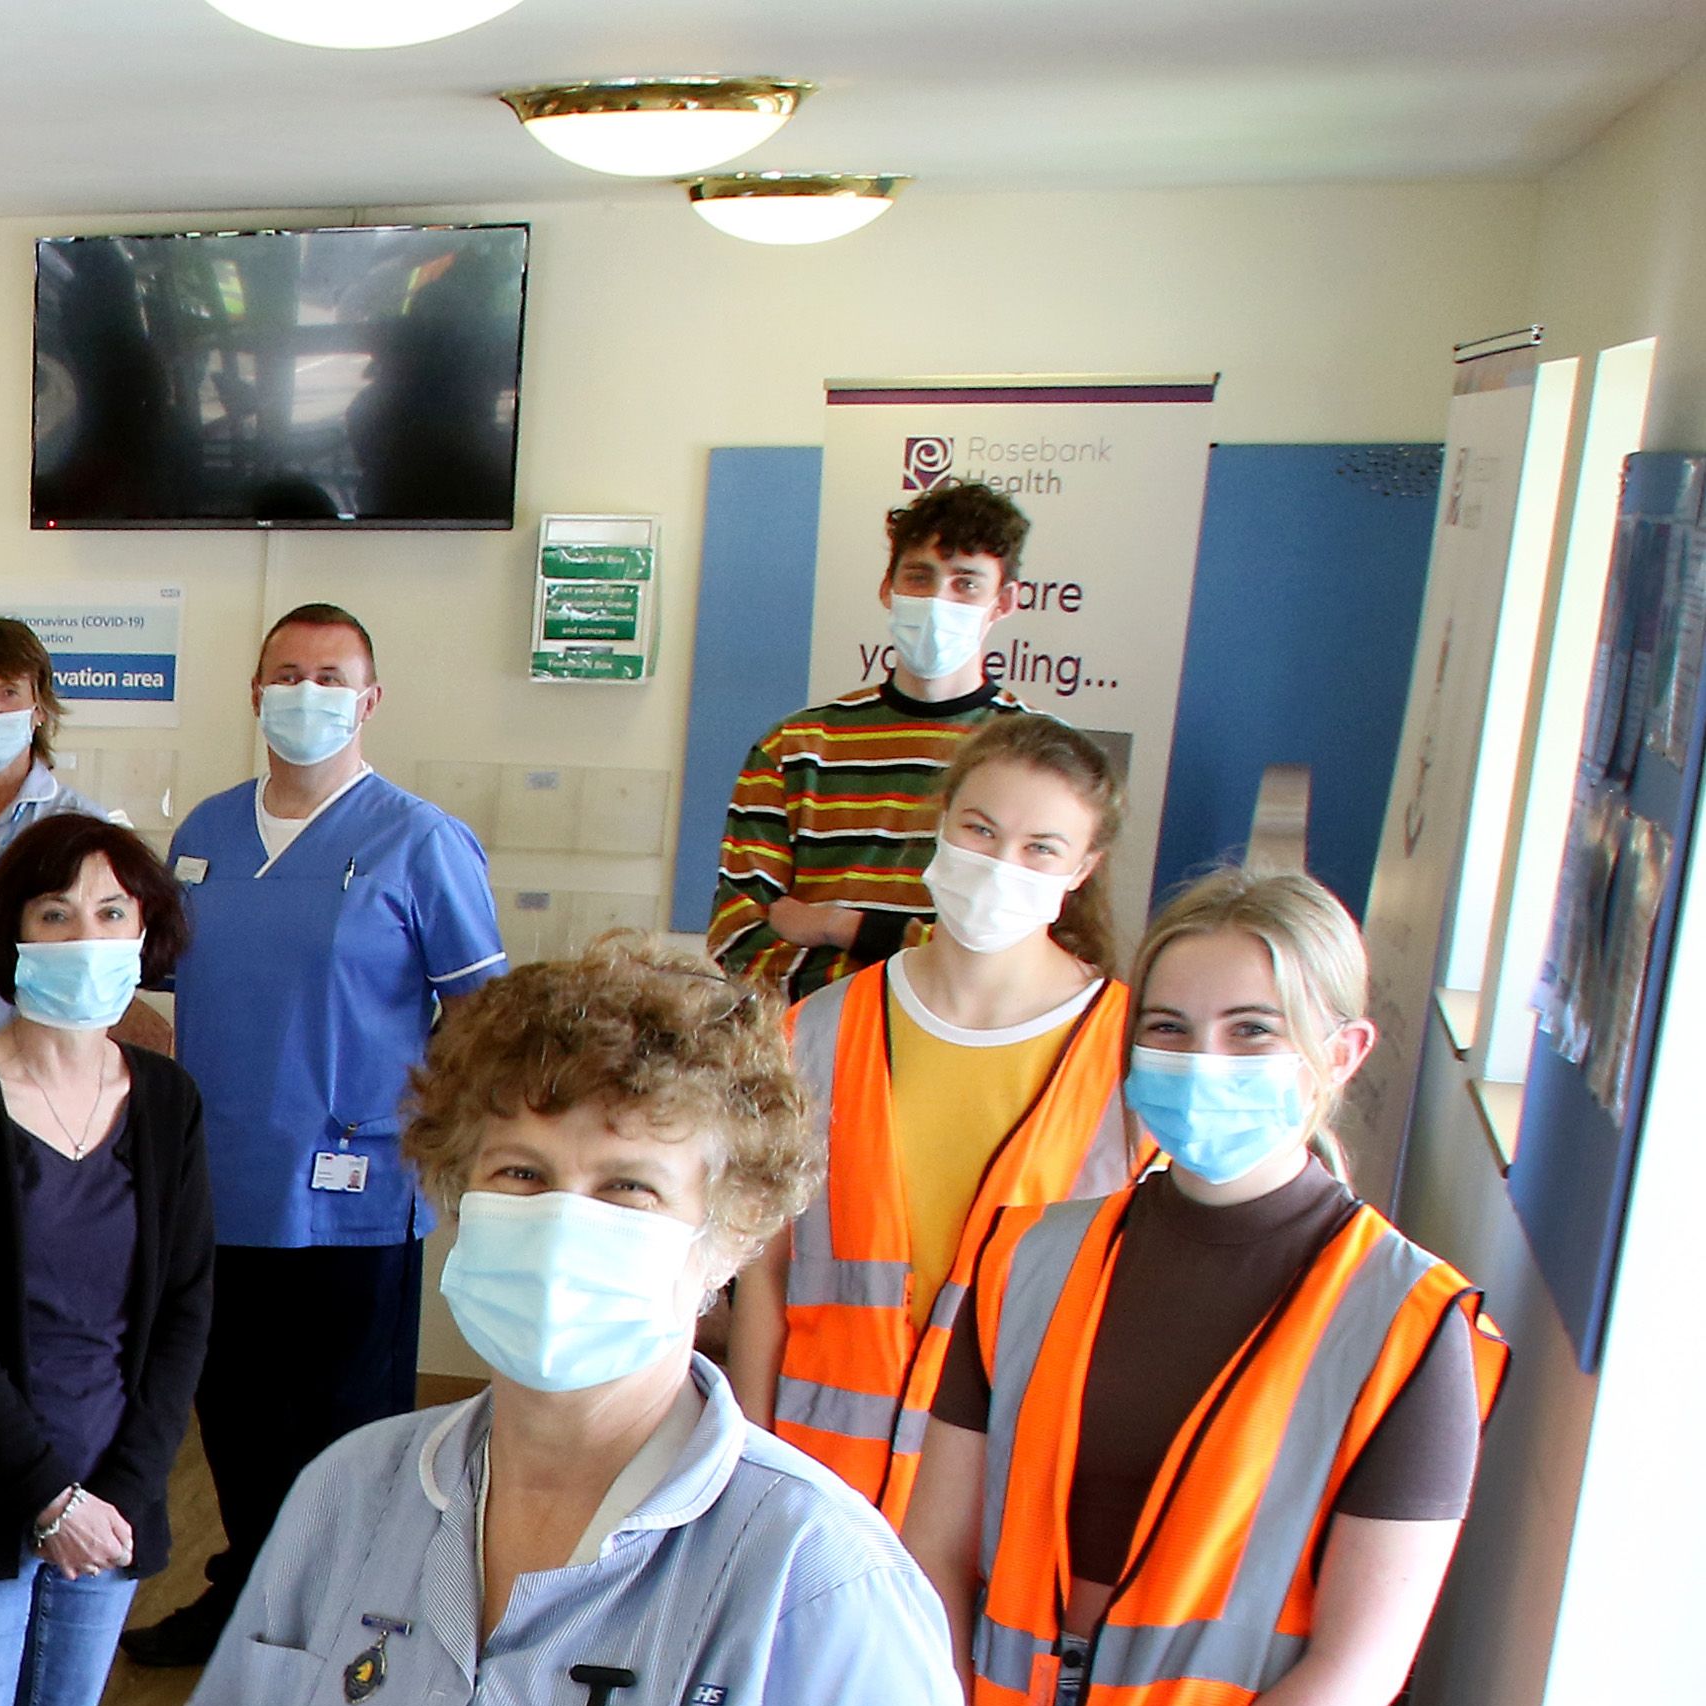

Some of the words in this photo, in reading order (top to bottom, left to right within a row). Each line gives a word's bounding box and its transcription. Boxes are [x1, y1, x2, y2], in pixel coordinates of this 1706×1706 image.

[967, 436, 1112, 463] Rosebank
[967, 468, 1062, 495] Health
[1017, 580, 1082, 613] are
[81, 616, 144, 628] (COVID-19)
[562, 626, 578, 635] and
[579, 627, 616, 635] concerns
[53, 668, 116, 687] rvation
[121, 673, 165, 688] area
[860, 643, 895, 682] yo
[981, 639, 1119, 696] eling...
[692, 1686, 724, 1703] HS
